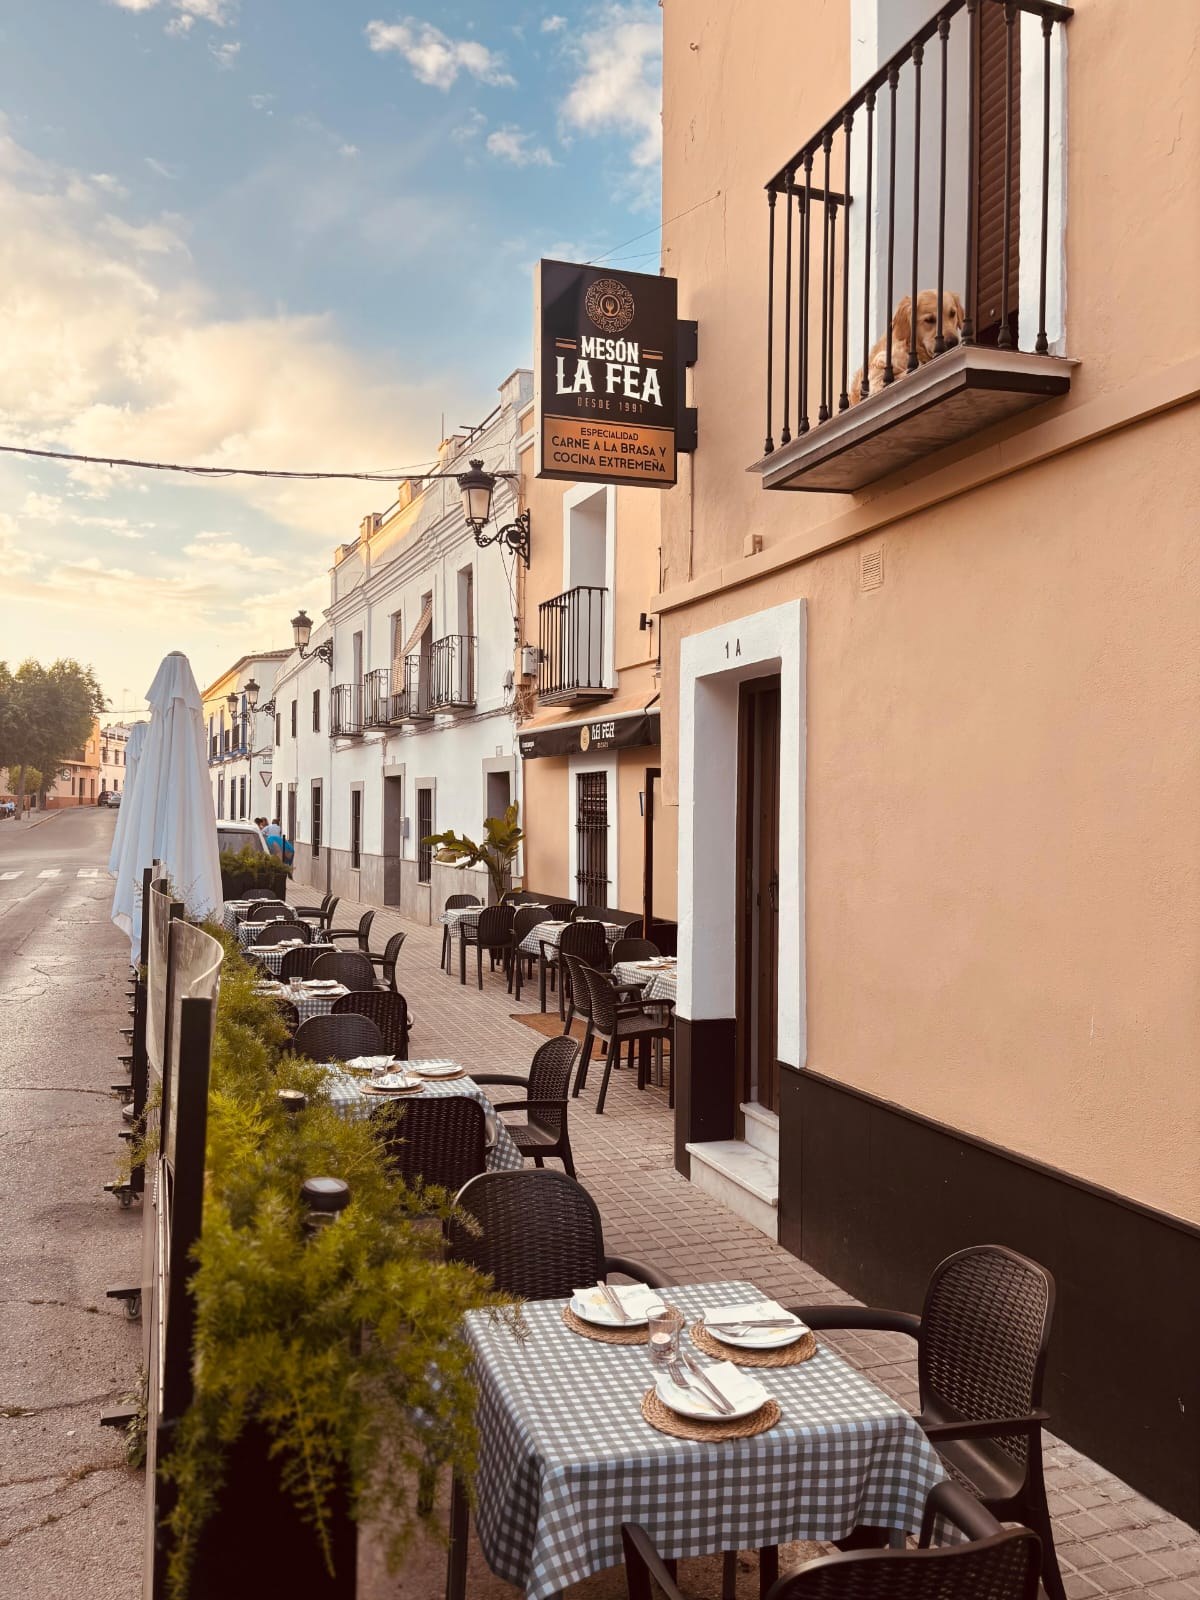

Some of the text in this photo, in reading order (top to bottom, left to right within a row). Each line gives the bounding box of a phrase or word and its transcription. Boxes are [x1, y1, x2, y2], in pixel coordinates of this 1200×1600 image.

[581, 335, 639, 364] MESÓN
[555, 355, 664, 407] LA FEA
[577, 396, 643, 414] DESDE 1991
[580, 427, 639, 441] ESPECIALIDAD
[551, 435, 667, 457] CARNE A LA BRASA Y
[553, 451, 666, 473] COCINA EXTREMEÑA
[725, 638, 742, 659] 1 A
[591, 722, 615, 740] LA FEA
